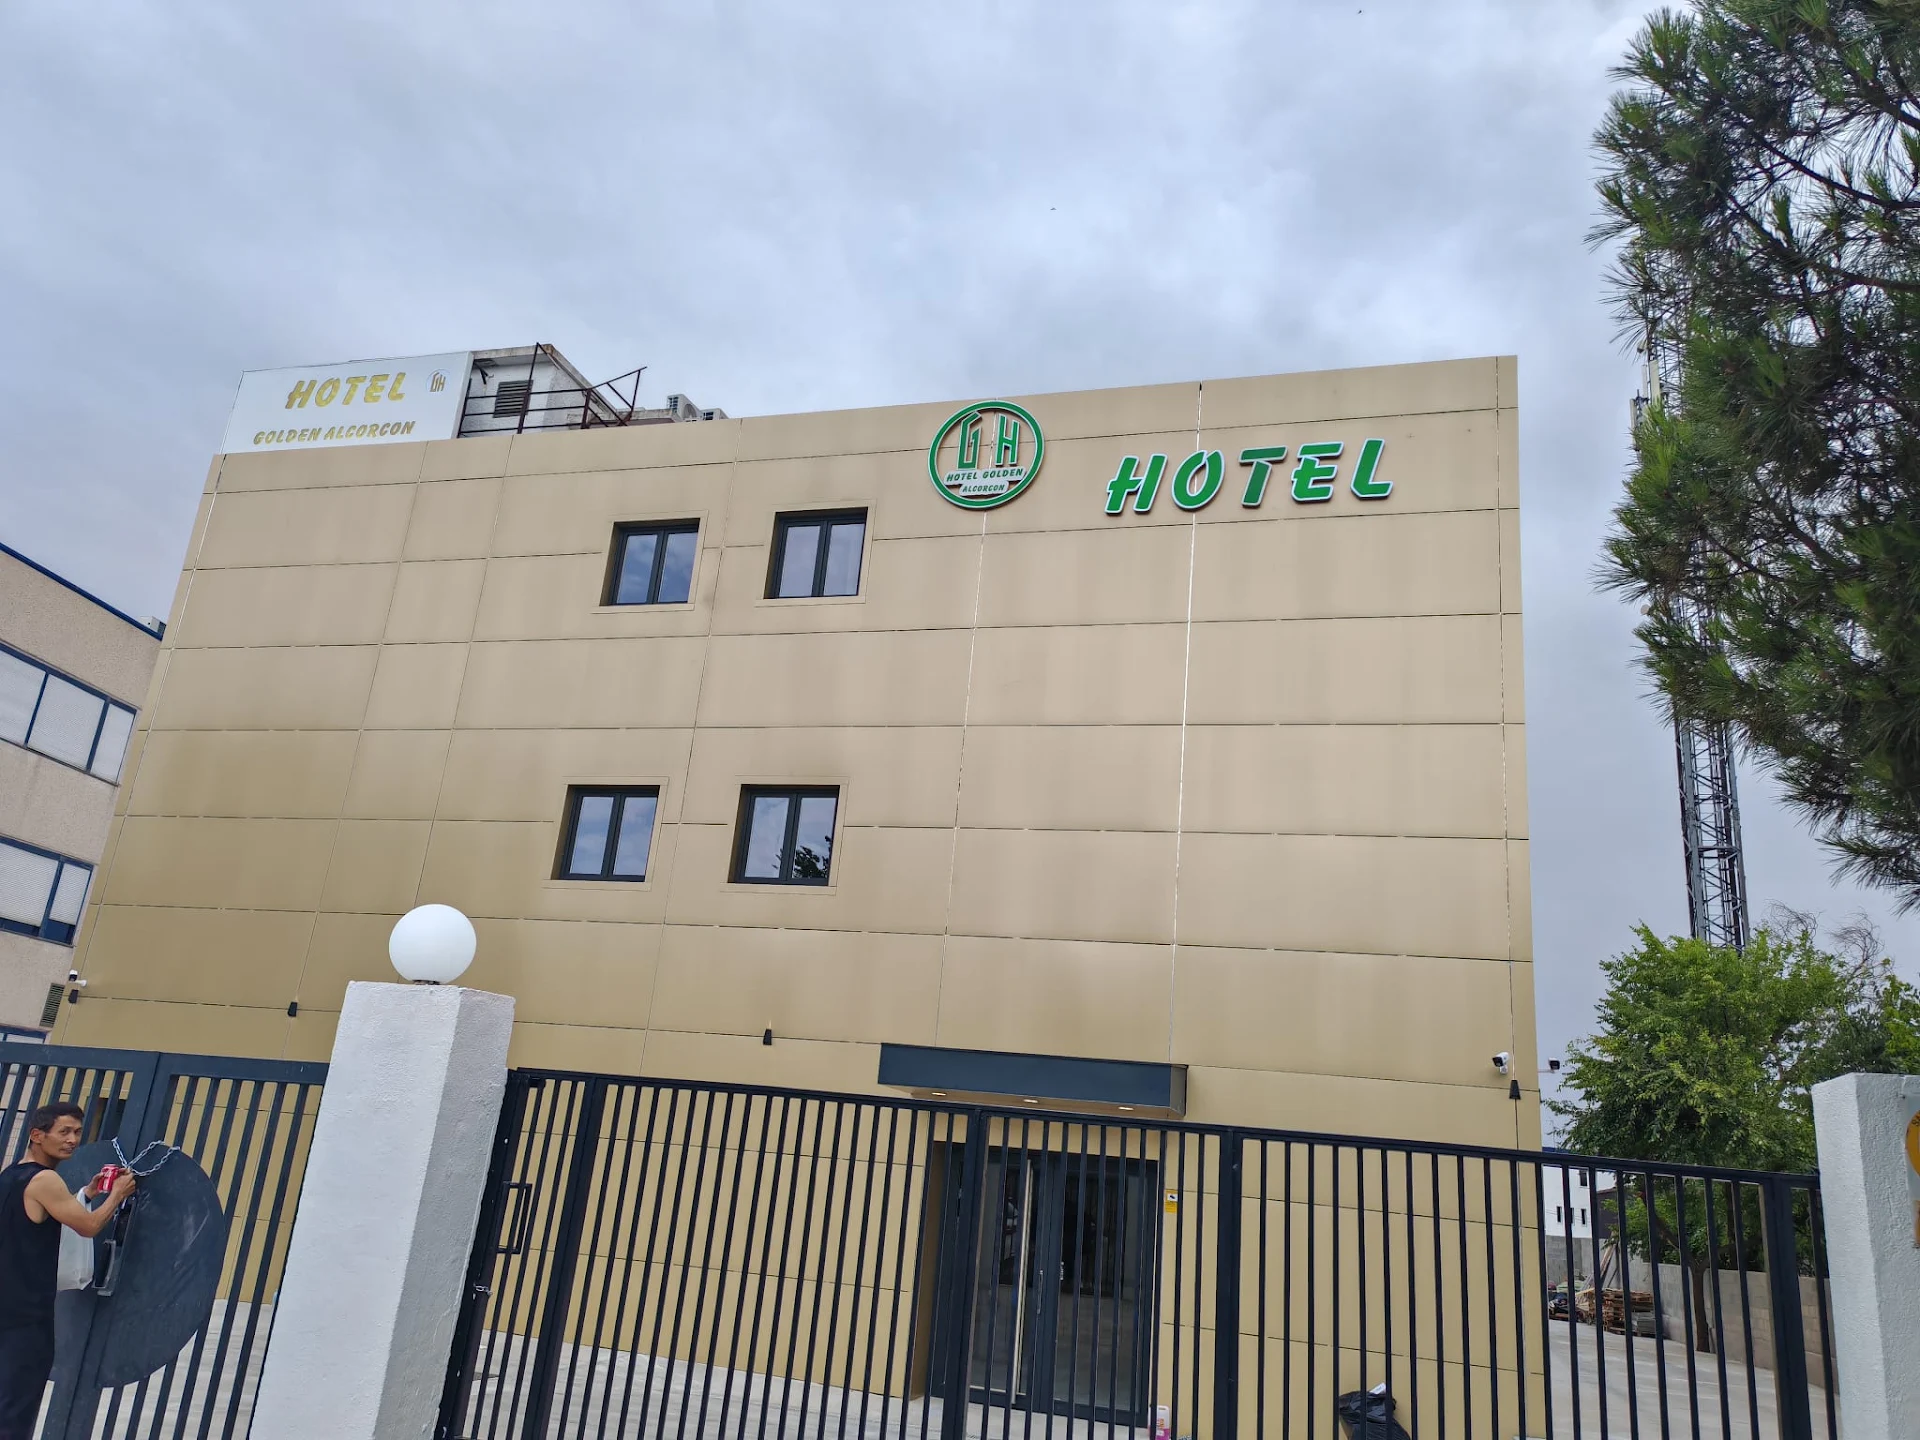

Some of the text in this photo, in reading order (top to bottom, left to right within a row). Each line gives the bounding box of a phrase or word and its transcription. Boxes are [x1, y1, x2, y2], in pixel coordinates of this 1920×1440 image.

[285, 372, 406, 409] HOTEL
[253, 421, 414, 445] GOLDEN ALCORCON
[946, 468, 1023, 482] HOTEL GOLDEN
[1105, 439, 1393, 513] HOTEL
[962, 484, 1005, 492] ALCORCON
